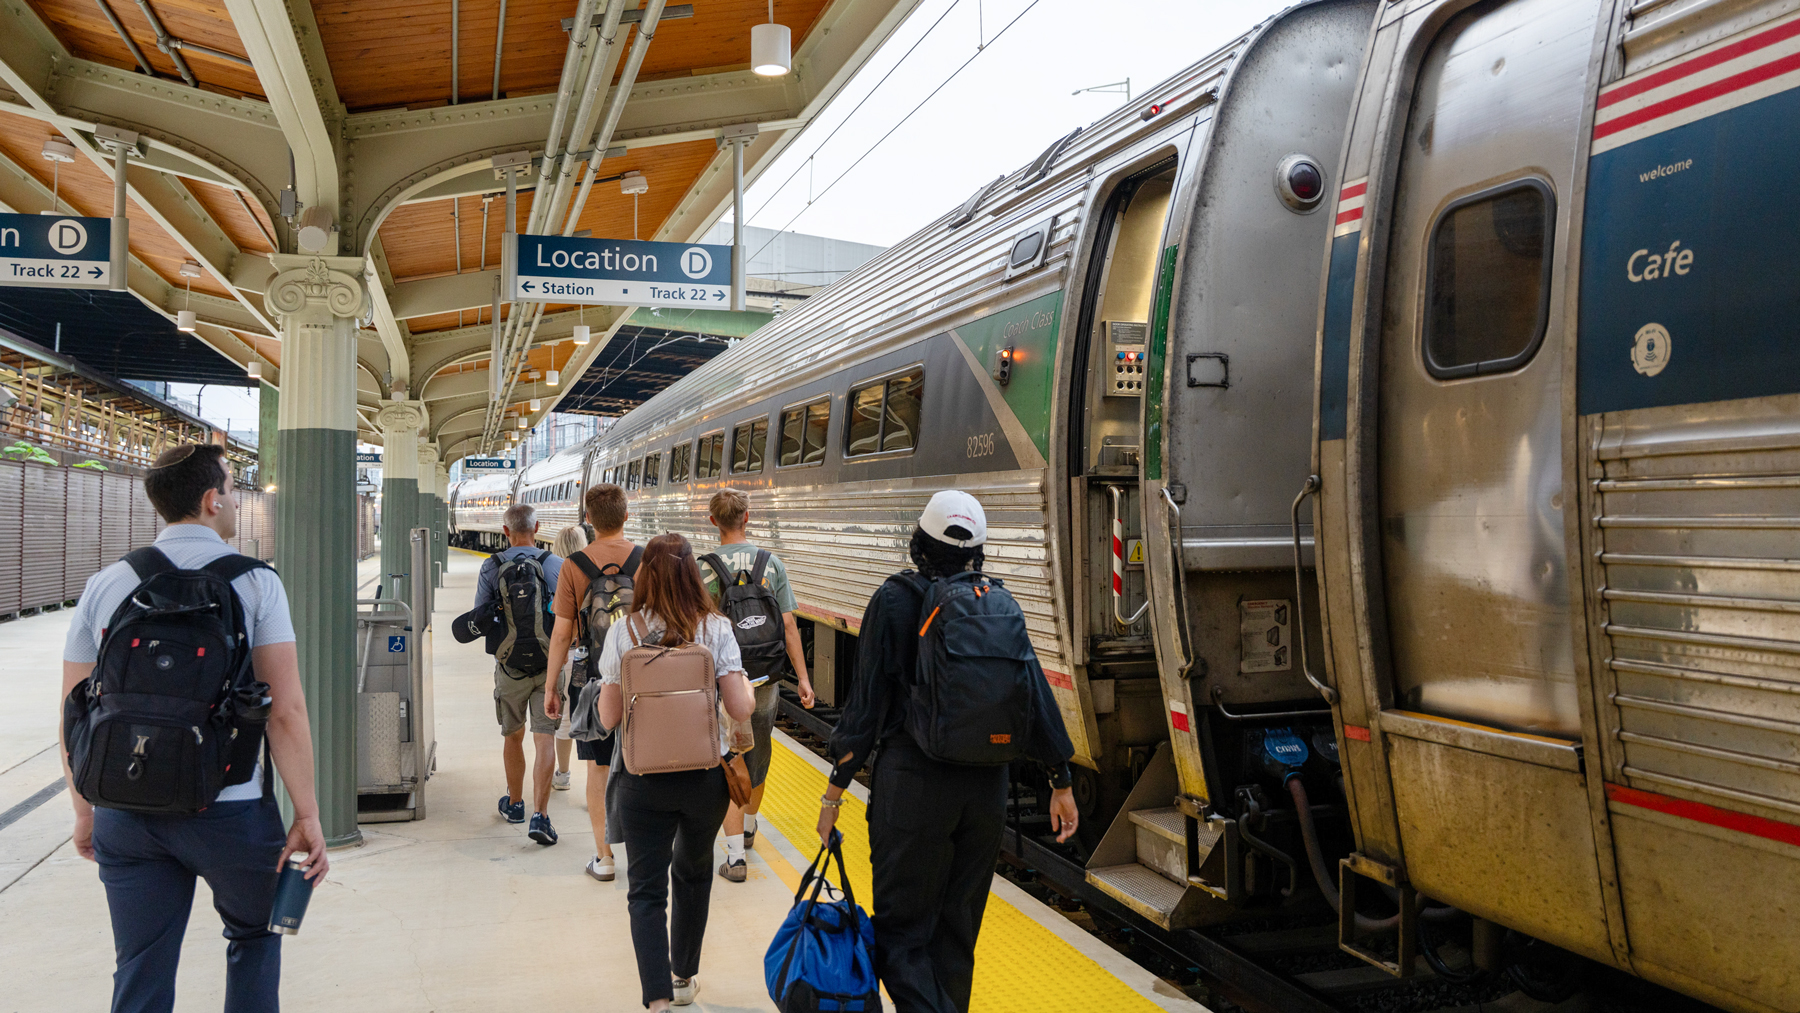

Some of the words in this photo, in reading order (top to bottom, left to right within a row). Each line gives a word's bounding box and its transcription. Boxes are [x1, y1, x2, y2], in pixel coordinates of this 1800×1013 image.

[1639, 158, 1693, 183] welcome
[58, 224, 81, 249] D
[10, 263, 55, 278] Track
[60, 265, 81, 279] 22
[536, 243, 658, 273] Location
[688, 251, 707, 275] D
[1627, 240, 1694, 283] Cafe
[542, 281, 595, 297] Station
[650, 286, 686, 301] Track
[690, 288, 707, 301] 22
[1003, 315, 1029, 339] Coach
[1031, 309, 1055, 330] Class
[966, 432, 995, 459] 82596
[469, 460, 499, 468] Location
